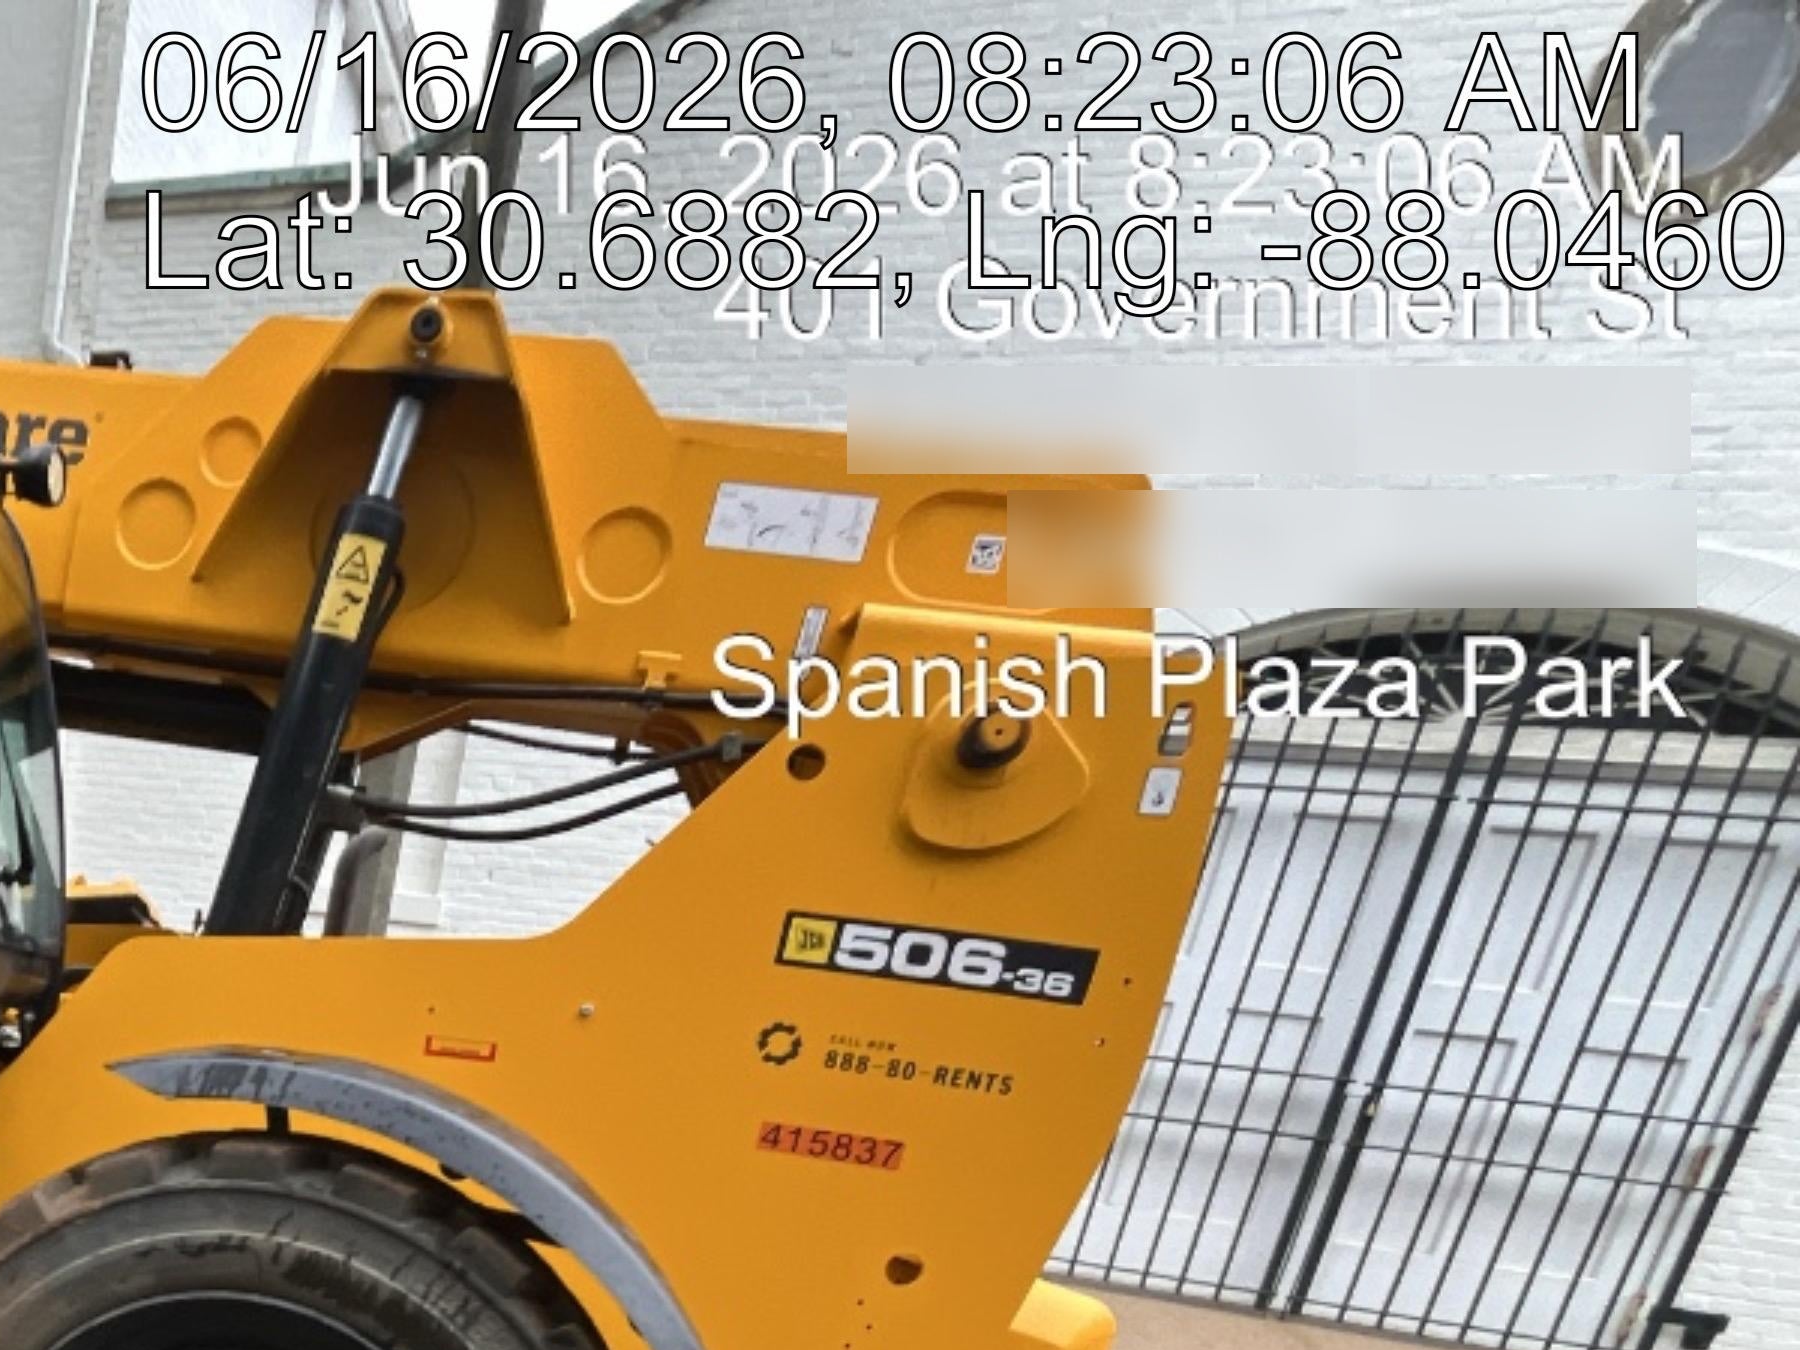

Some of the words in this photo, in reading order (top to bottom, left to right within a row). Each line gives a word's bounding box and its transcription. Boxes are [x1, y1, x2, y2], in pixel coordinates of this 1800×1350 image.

[833, 922, 1076, 997] 506-36
[823, 1049, 1015, 1096] 888-80-RENTS
[759, 1123, 904, 1170] 415837
